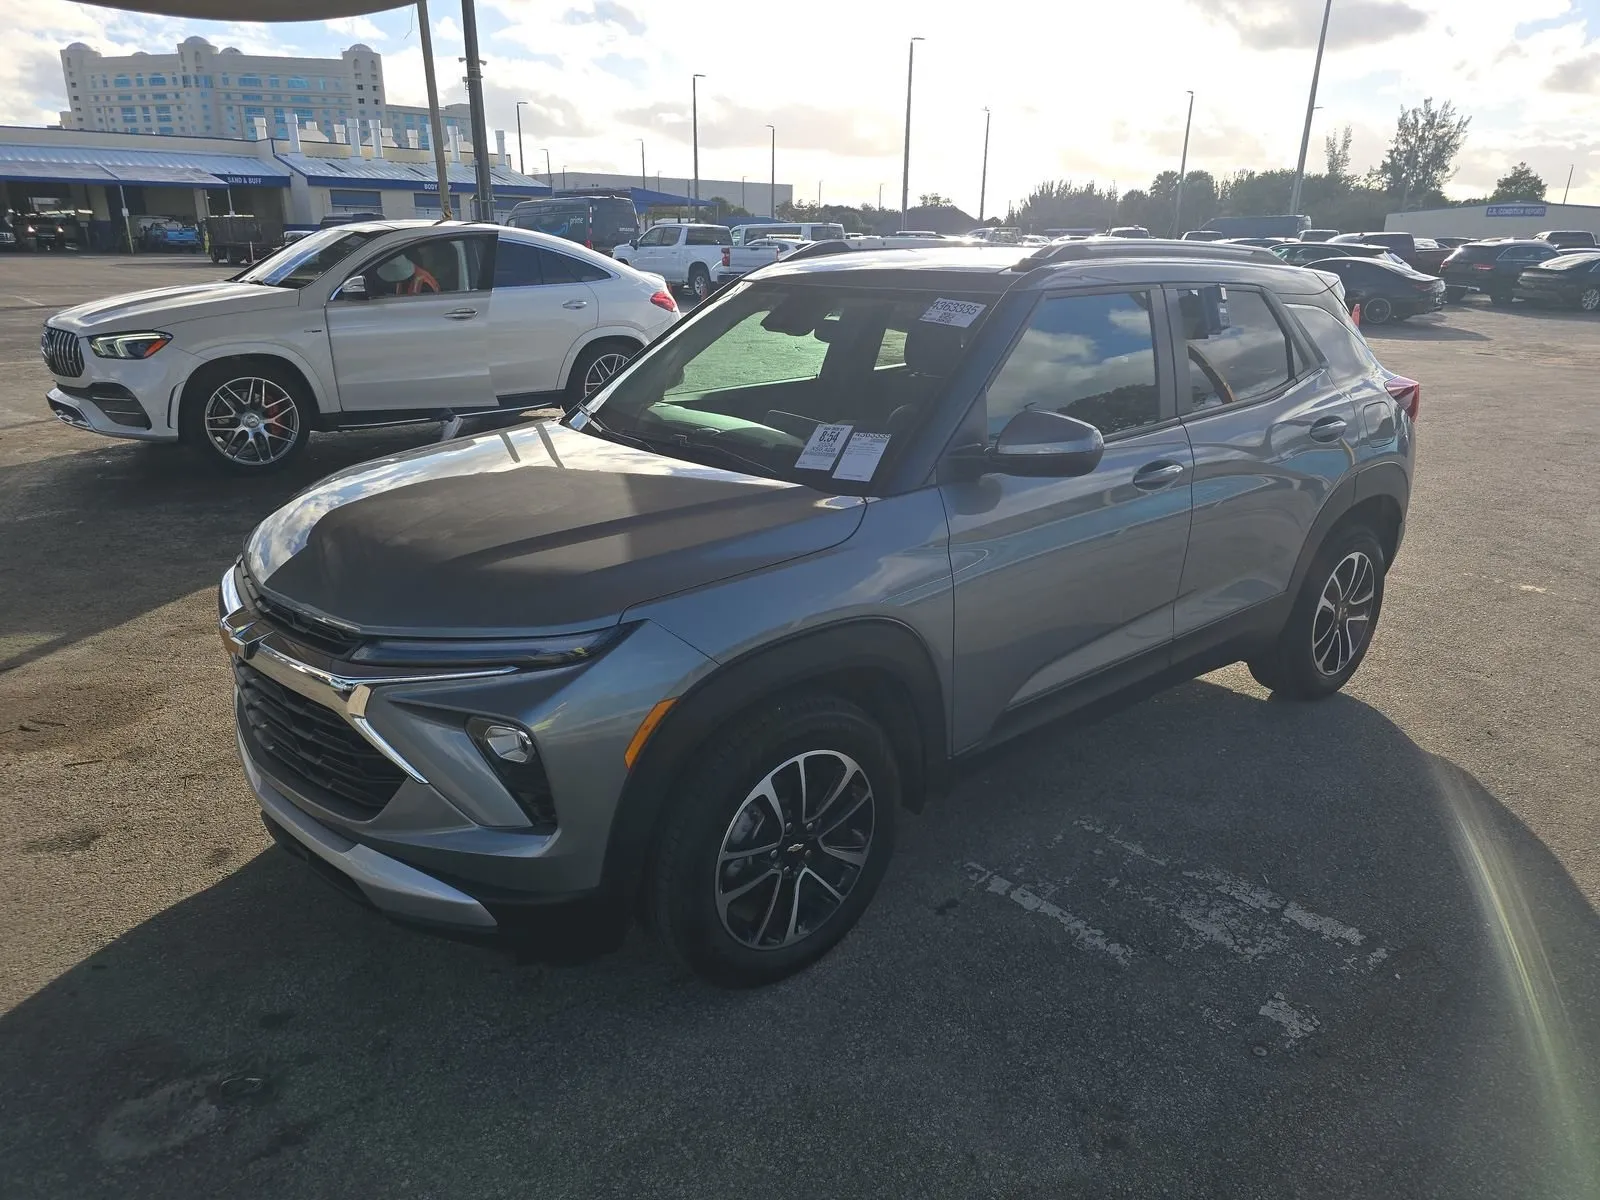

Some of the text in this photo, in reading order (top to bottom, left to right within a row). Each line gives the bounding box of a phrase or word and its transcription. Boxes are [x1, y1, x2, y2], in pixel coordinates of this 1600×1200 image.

[227, 176, 242, 184] SAND
[569, 215, 584, 227] prime
[819, 430, 840, 442] 8:54
